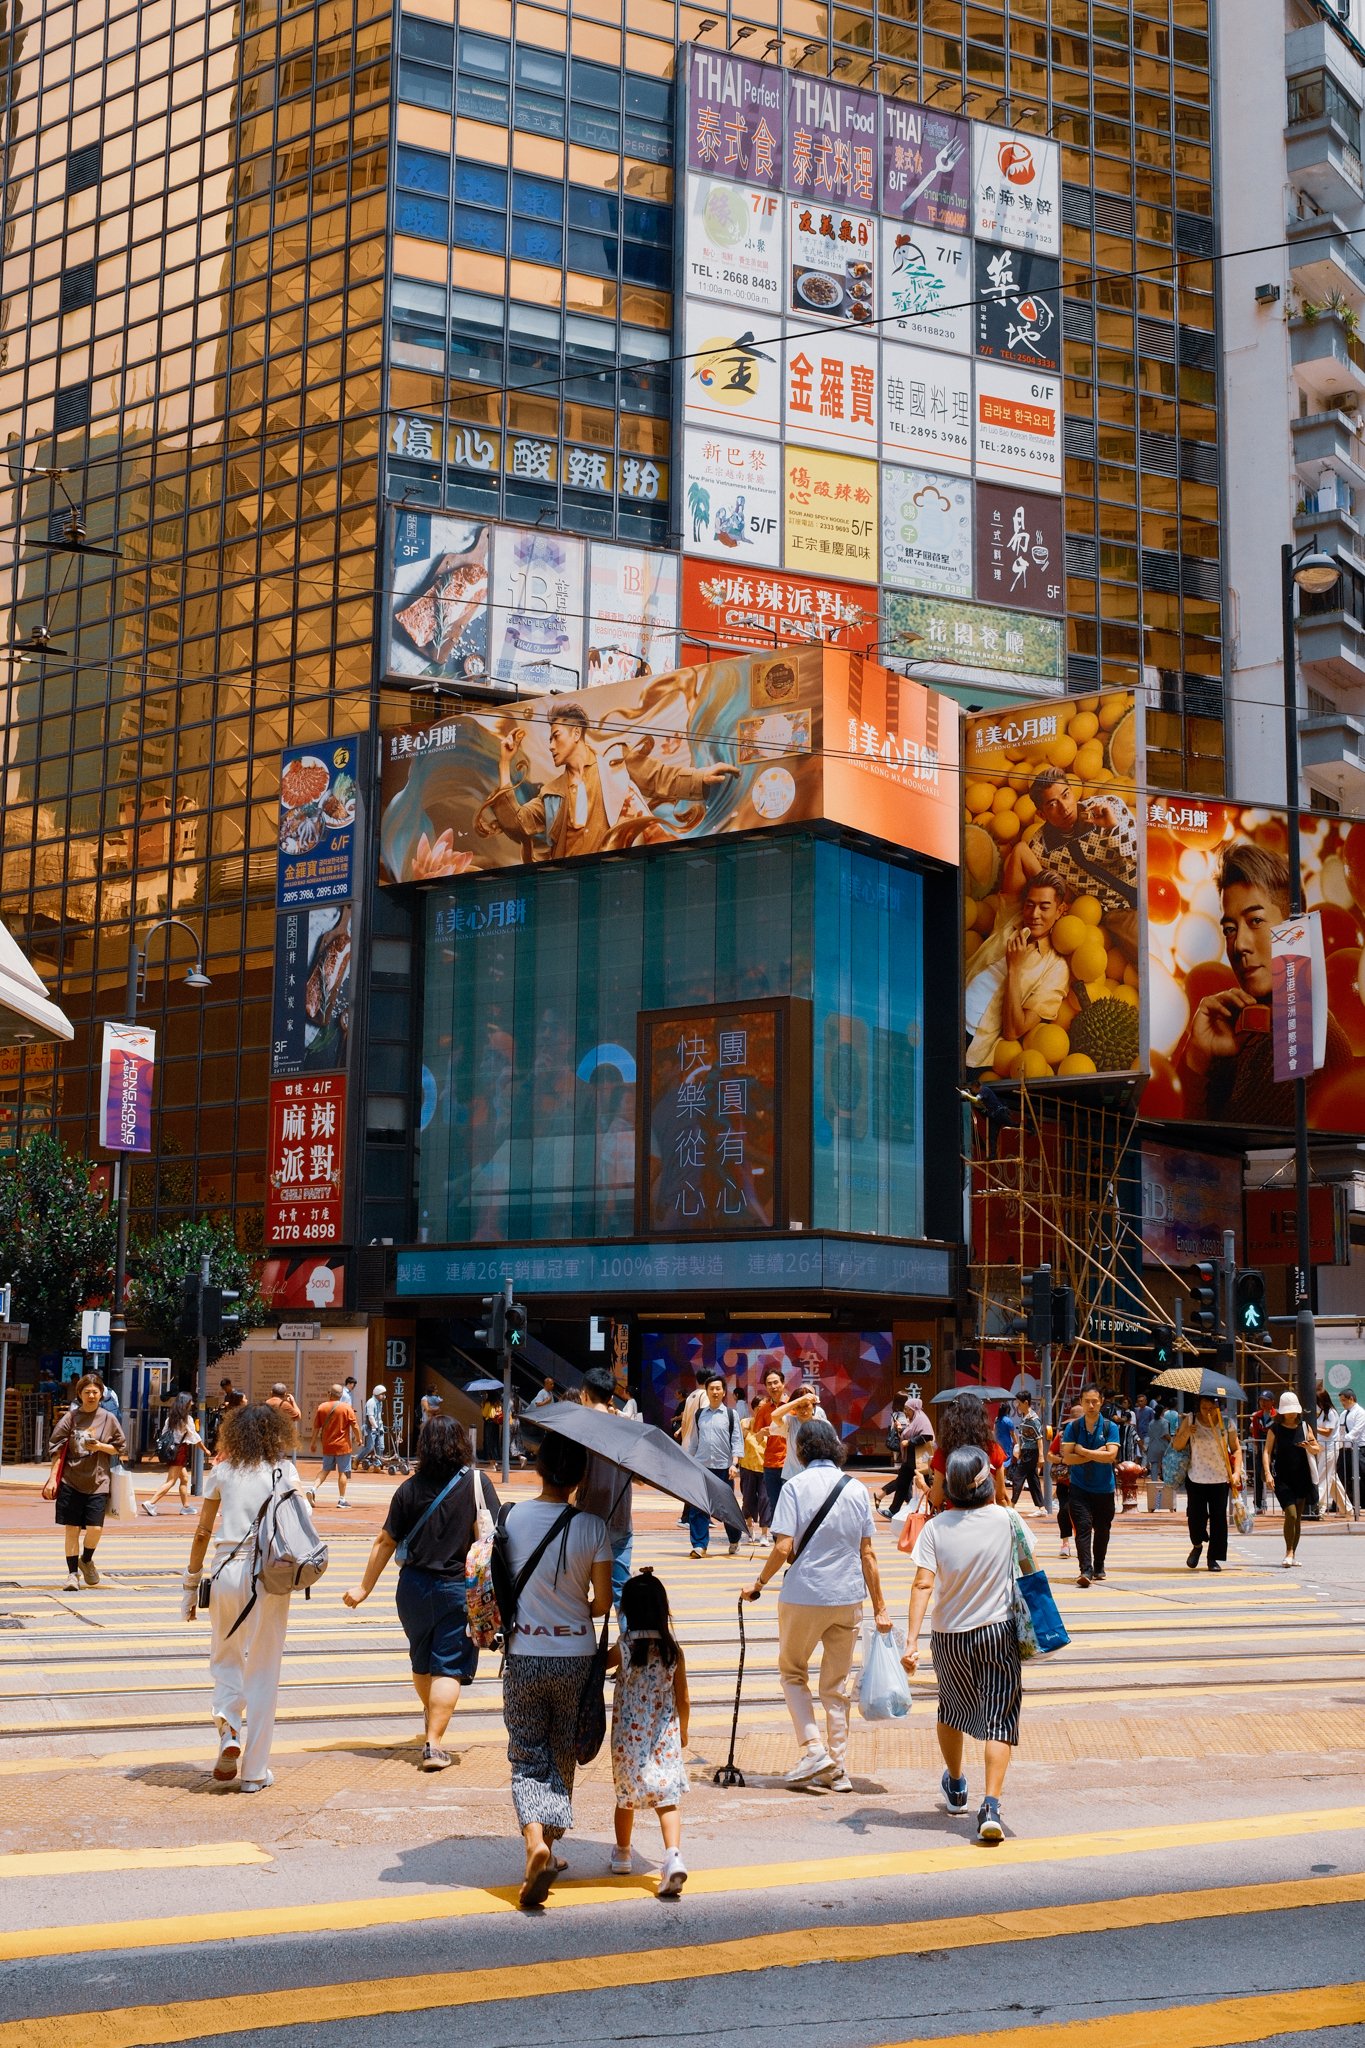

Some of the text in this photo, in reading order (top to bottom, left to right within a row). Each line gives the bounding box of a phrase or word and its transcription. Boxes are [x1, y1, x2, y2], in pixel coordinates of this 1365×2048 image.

[695, 53, 779, 109] THAI Perfect
[792, 78, 874, 134] THAI Food
[887, 108, 921, 144] THAI
[624, 140, 671, 157] PERFECT
[697, 106, 776, 179] 泰式食
[793, 128, 873, 201] 泰式料理
[889, 171, 907, 191] 8/F
[751, 194, 778, 216] 7/F
[982, 219, 1052, 244] 8/F 2351 1323
[936, 247, 962, 265] 7/F
[723, 270, 748, 285] 2668
[752, 277, 777, 292] 8483
[912, 323, 955, 339] 36188230
[980, 346, 1056, 368] 7/F TEL: 2504 3338
[790, 352, 874, 427] 金羅寶
[1031, 384, 1053, 400] 6/F
[888, 376, 969, 427] 韓國料理
[984, 402, 1050, 429] 금라보 한국요리
[941, 432, 967, 446] 3986
[988, 426, 997, 434] Luo
[1010, 430, 1028, 441] Korean
[1029, 435, 1055, 446] Restaurant
[701, 440, 767, 471] 新巴黎
[1029, 450, 1055, 463] 6398
[716, 479, 747, 490] Vietnamese
[748, 485, 777, 494] Restaurant
[789, 467, 873, 505] 傷心酸辣粉
[750, 516, 777, 534] 5/F
[820, 523, 834, 531] 2333
[829, 516, 850, 524] NOODLE
[851, 519, 874, 537] 5/F
[402, 545, 420, 557] 3F
[792, 535, 871, 560] 正宗重慶風味
[993, 510, 1002, 580] 台式料理
[897, 556, 912, 564] Meet
[926, 561, 957, 572] Restaurant
[725, 576, 843, 620] 麻辣派對
[921, 580, 967, 595] 2387 9388
[1047, 585, 1060, 599] 5F
[725, 609, 776, 633] CHILI
[780, 617, 841, 642] PARTY
[955, 648, 981, 657] GARDEN
[983, 652, 1024, 664] RESTAURANT
[398, 724, 457, 754] 美心月餅
[848, 718, 858, 753] 香港
[976, 728, 984, 748] 香港
[985, 716, 1057, 746] 美心月餅
[1022, 736, 1057, 746] MOONCAKES
[860, 721, 939, 785] 美心月餅
[848, 756, 940, 796] HONG KONG MX MOONCAKES
[1150, 804, 1208, 829] 美心月餅
[331, 835, 350, 851] 6/F
[284, 861, 318, 881] 金羅寶
[318, 863, 348, 876] 韓國料理
[283, 891, 298, 904] 2895
[316, 886, 332, 898] 2895
[332, 883, 348, 895] 6398
[446, 899, 526, 933] 美心月餅
[274, 1040, 288, 1053] 3F
[313, 1081, 332, 1094] 4/F
[121, 1090, 129, 1121] WORLD
[126, 1059, 138, 1145] HONG KONG
[282, 1102, 336, 1141] 麻辣
[675, 1033, 708, 1216] 快樂從心
[716, 1031, 748, 1214] 團圓有心
[280, 1144, 335, 1184] 派對
[280, 1187, 332, 1201] CHILI PARTY
[1143, 1181, 1167, 1221] iB
[310, 1207, 330, 1221] 訂座
[272, 1224, 335, 1240] 2178 4898
[600, 1255, 724, 1278] 100%香港製造
[1095, 1319, 1141, 1332] THE BODY SHOP
[386, 1340, 407, 1368] iB
[903, 1345, 932, 1374] iB
[514, 1624, 587, 1637] NAEJ
